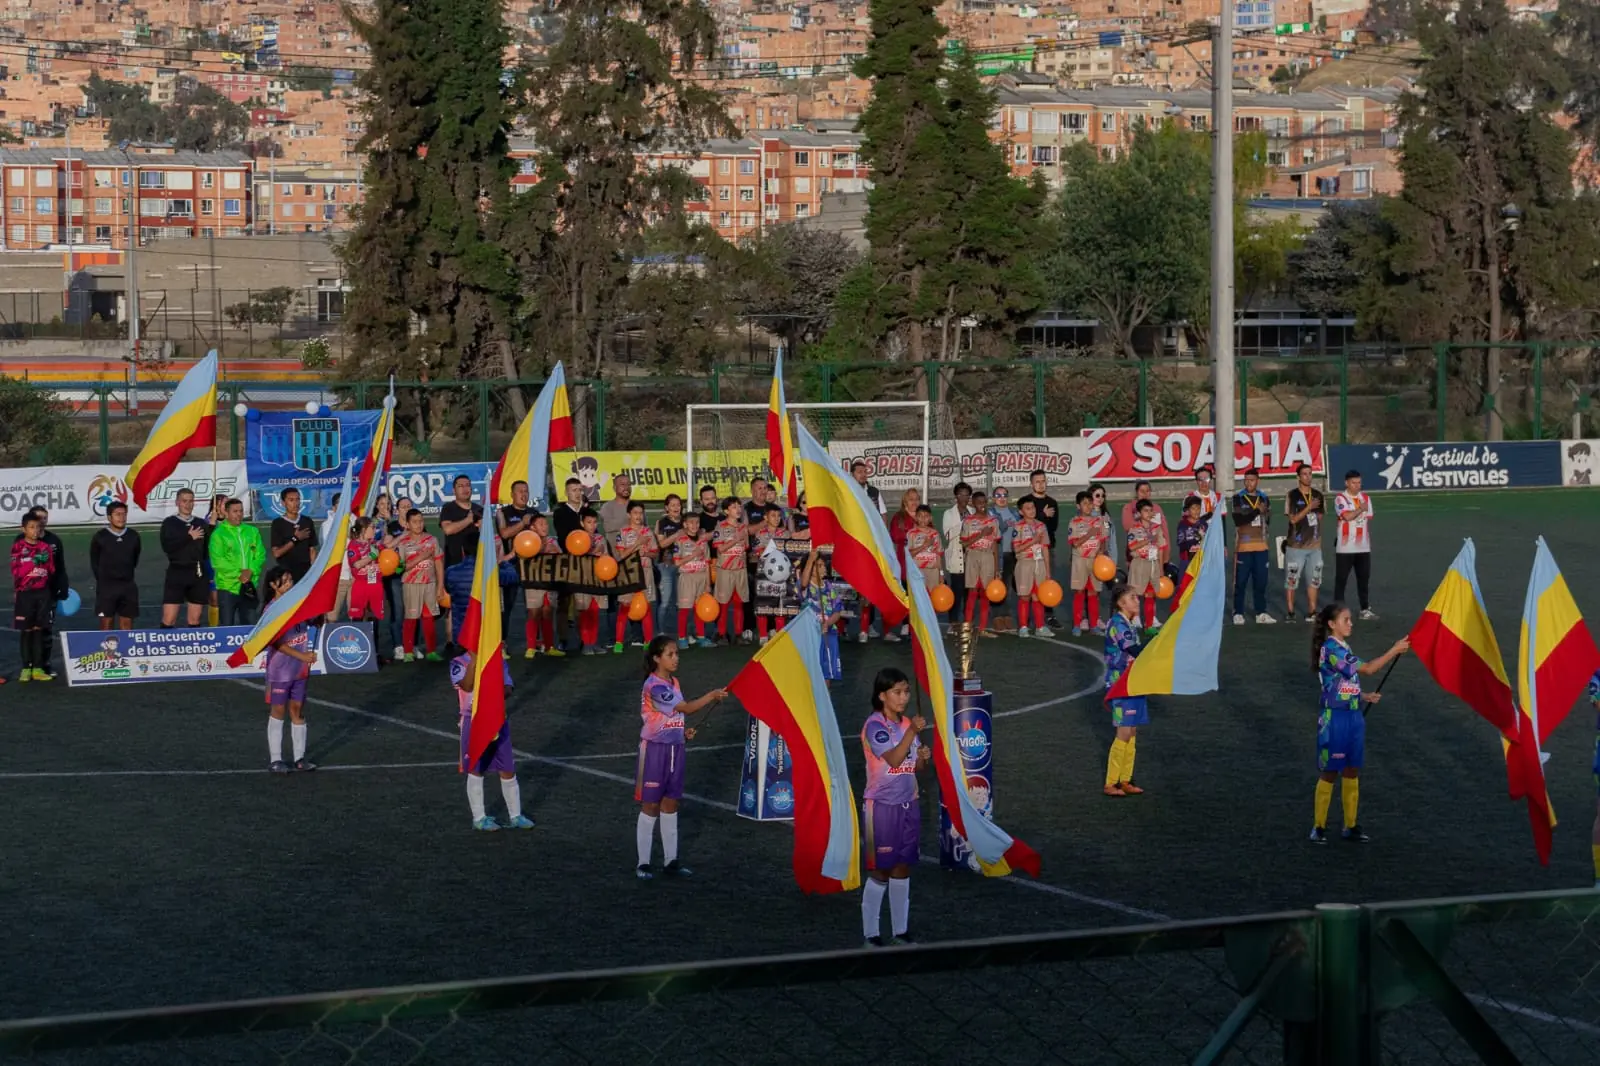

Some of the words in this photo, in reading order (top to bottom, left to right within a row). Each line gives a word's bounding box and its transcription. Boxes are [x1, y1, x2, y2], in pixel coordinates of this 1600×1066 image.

[300, 420, 333, 431] CLUB
[1132, 430, 1312, 472] SOACHA
[1422, 446, 1480, 468] Festival
[1482, 446, 1499, 465] de
[842, 456, 875, 477] LS
[995, 452, 1072, 475] PAISITAS
[24, 483, 62, 492] MUNICIPAL
[268, 478, 290, 486] CLUB
[291, 476, 338, 485] DEPORTIVO
[0, 491, 80, 512] OACHA
[150, 631, 216, 642] Encuentro
[128, 645, 144, 656] de
[148, 644, 166, 656] los
[153, 663, 191, 672] SOACHA
[749, 724, 758, 761] VIGOR
[960, 735, 985, 748] VIGOR
